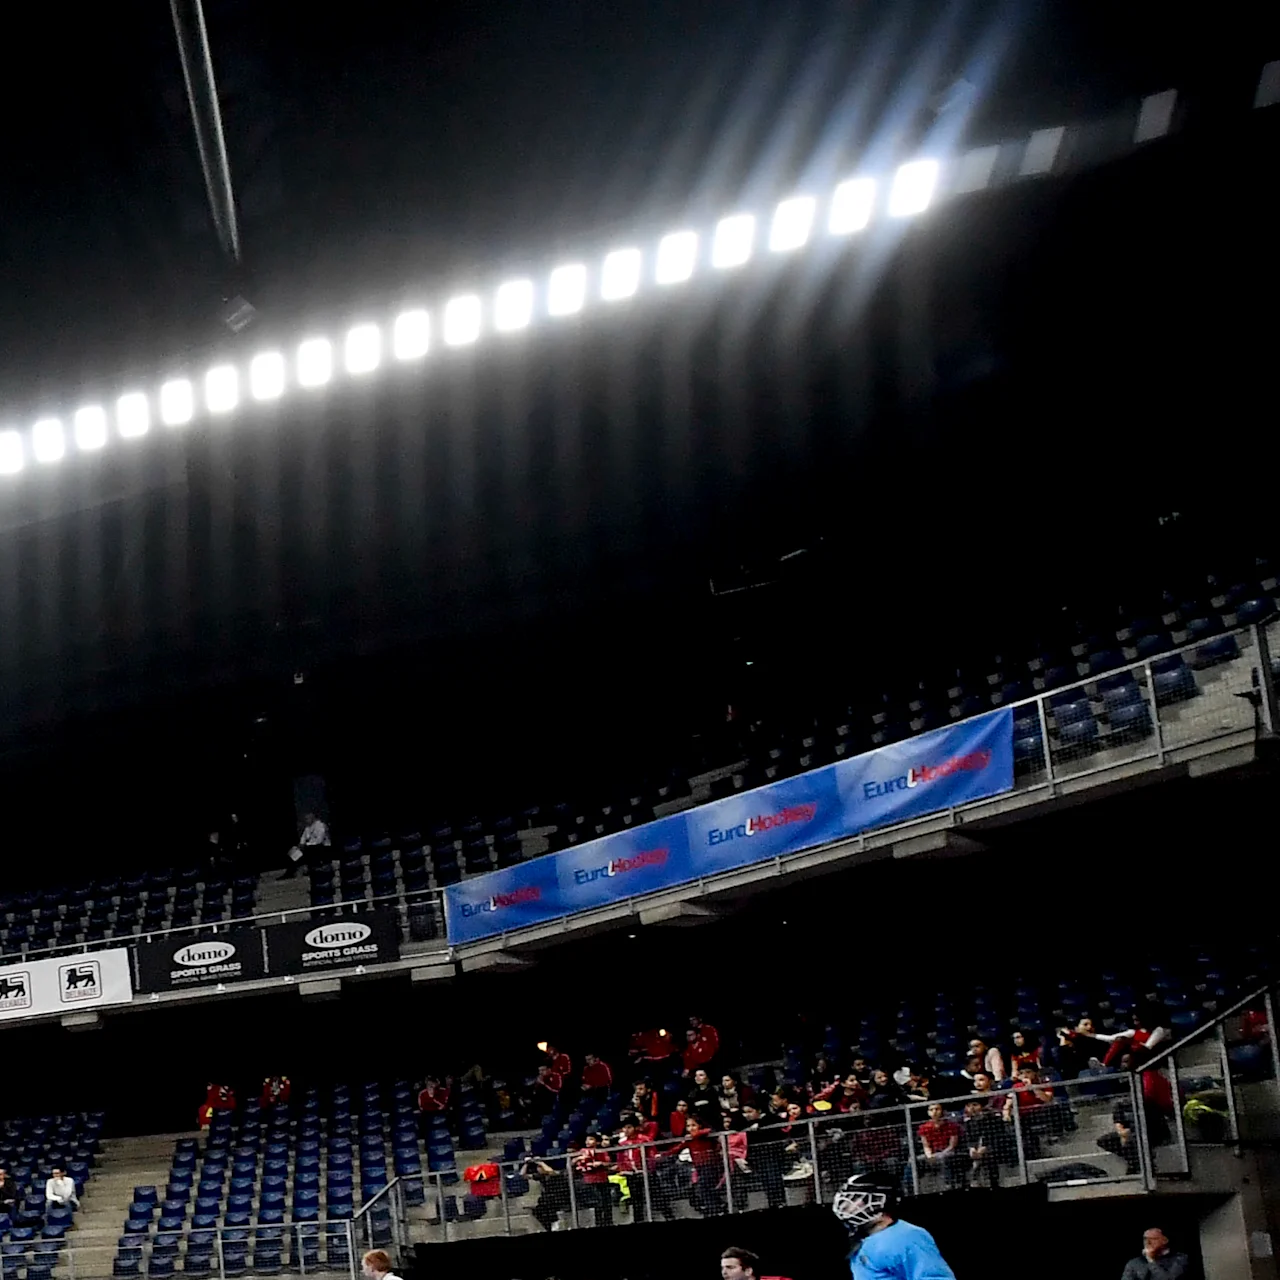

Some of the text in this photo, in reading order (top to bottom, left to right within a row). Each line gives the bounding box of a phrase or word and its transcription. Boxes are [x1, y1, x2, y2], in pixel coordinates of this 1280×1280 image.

[313, 930, 364, 945] domo
[181, 949, 229, 962] domo
[302, 944, 379, 961] SPORTS GRASS
[170, 962, 242, 978] SPORTS GRASS
[65, 988, 98, 999] DELHAIZE
